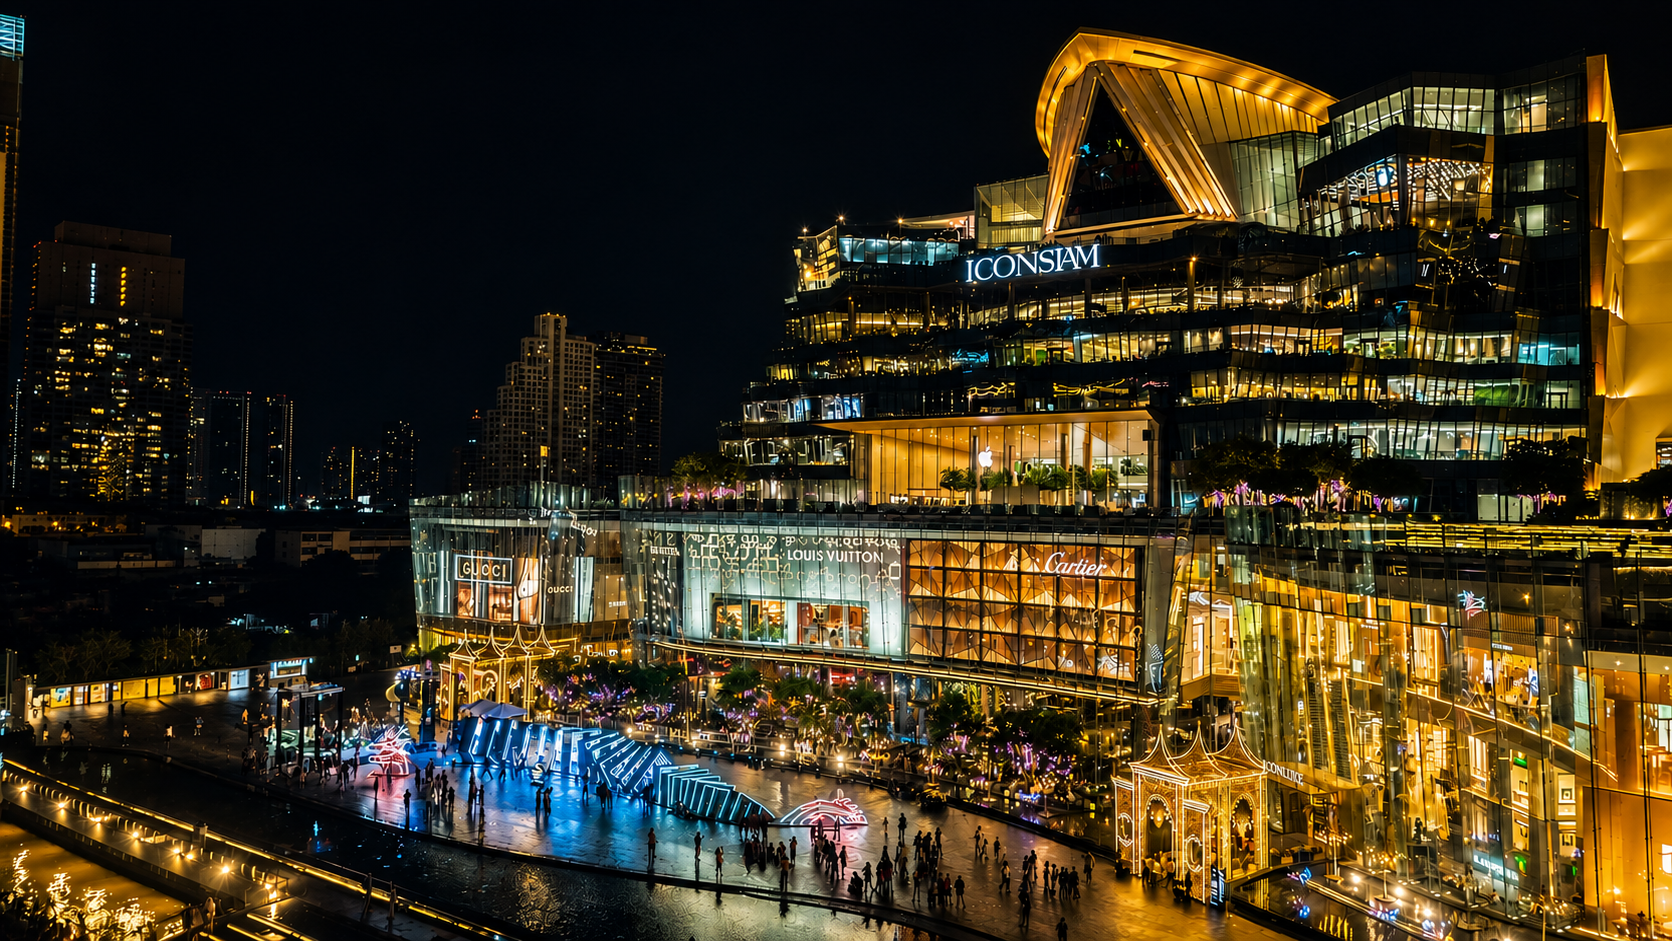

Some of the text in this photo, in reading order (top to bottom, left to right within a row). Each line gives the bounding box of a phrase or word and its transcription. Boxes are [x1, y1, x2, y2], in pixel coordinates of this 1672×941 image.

[965, 243, 1100, 282] ICONSIAM
[787, 549, 884, 563] LOUIS VUITTON
[1044, 551, 1107, 576] Cartier
[462, 561, 506, 578] GUCCI
